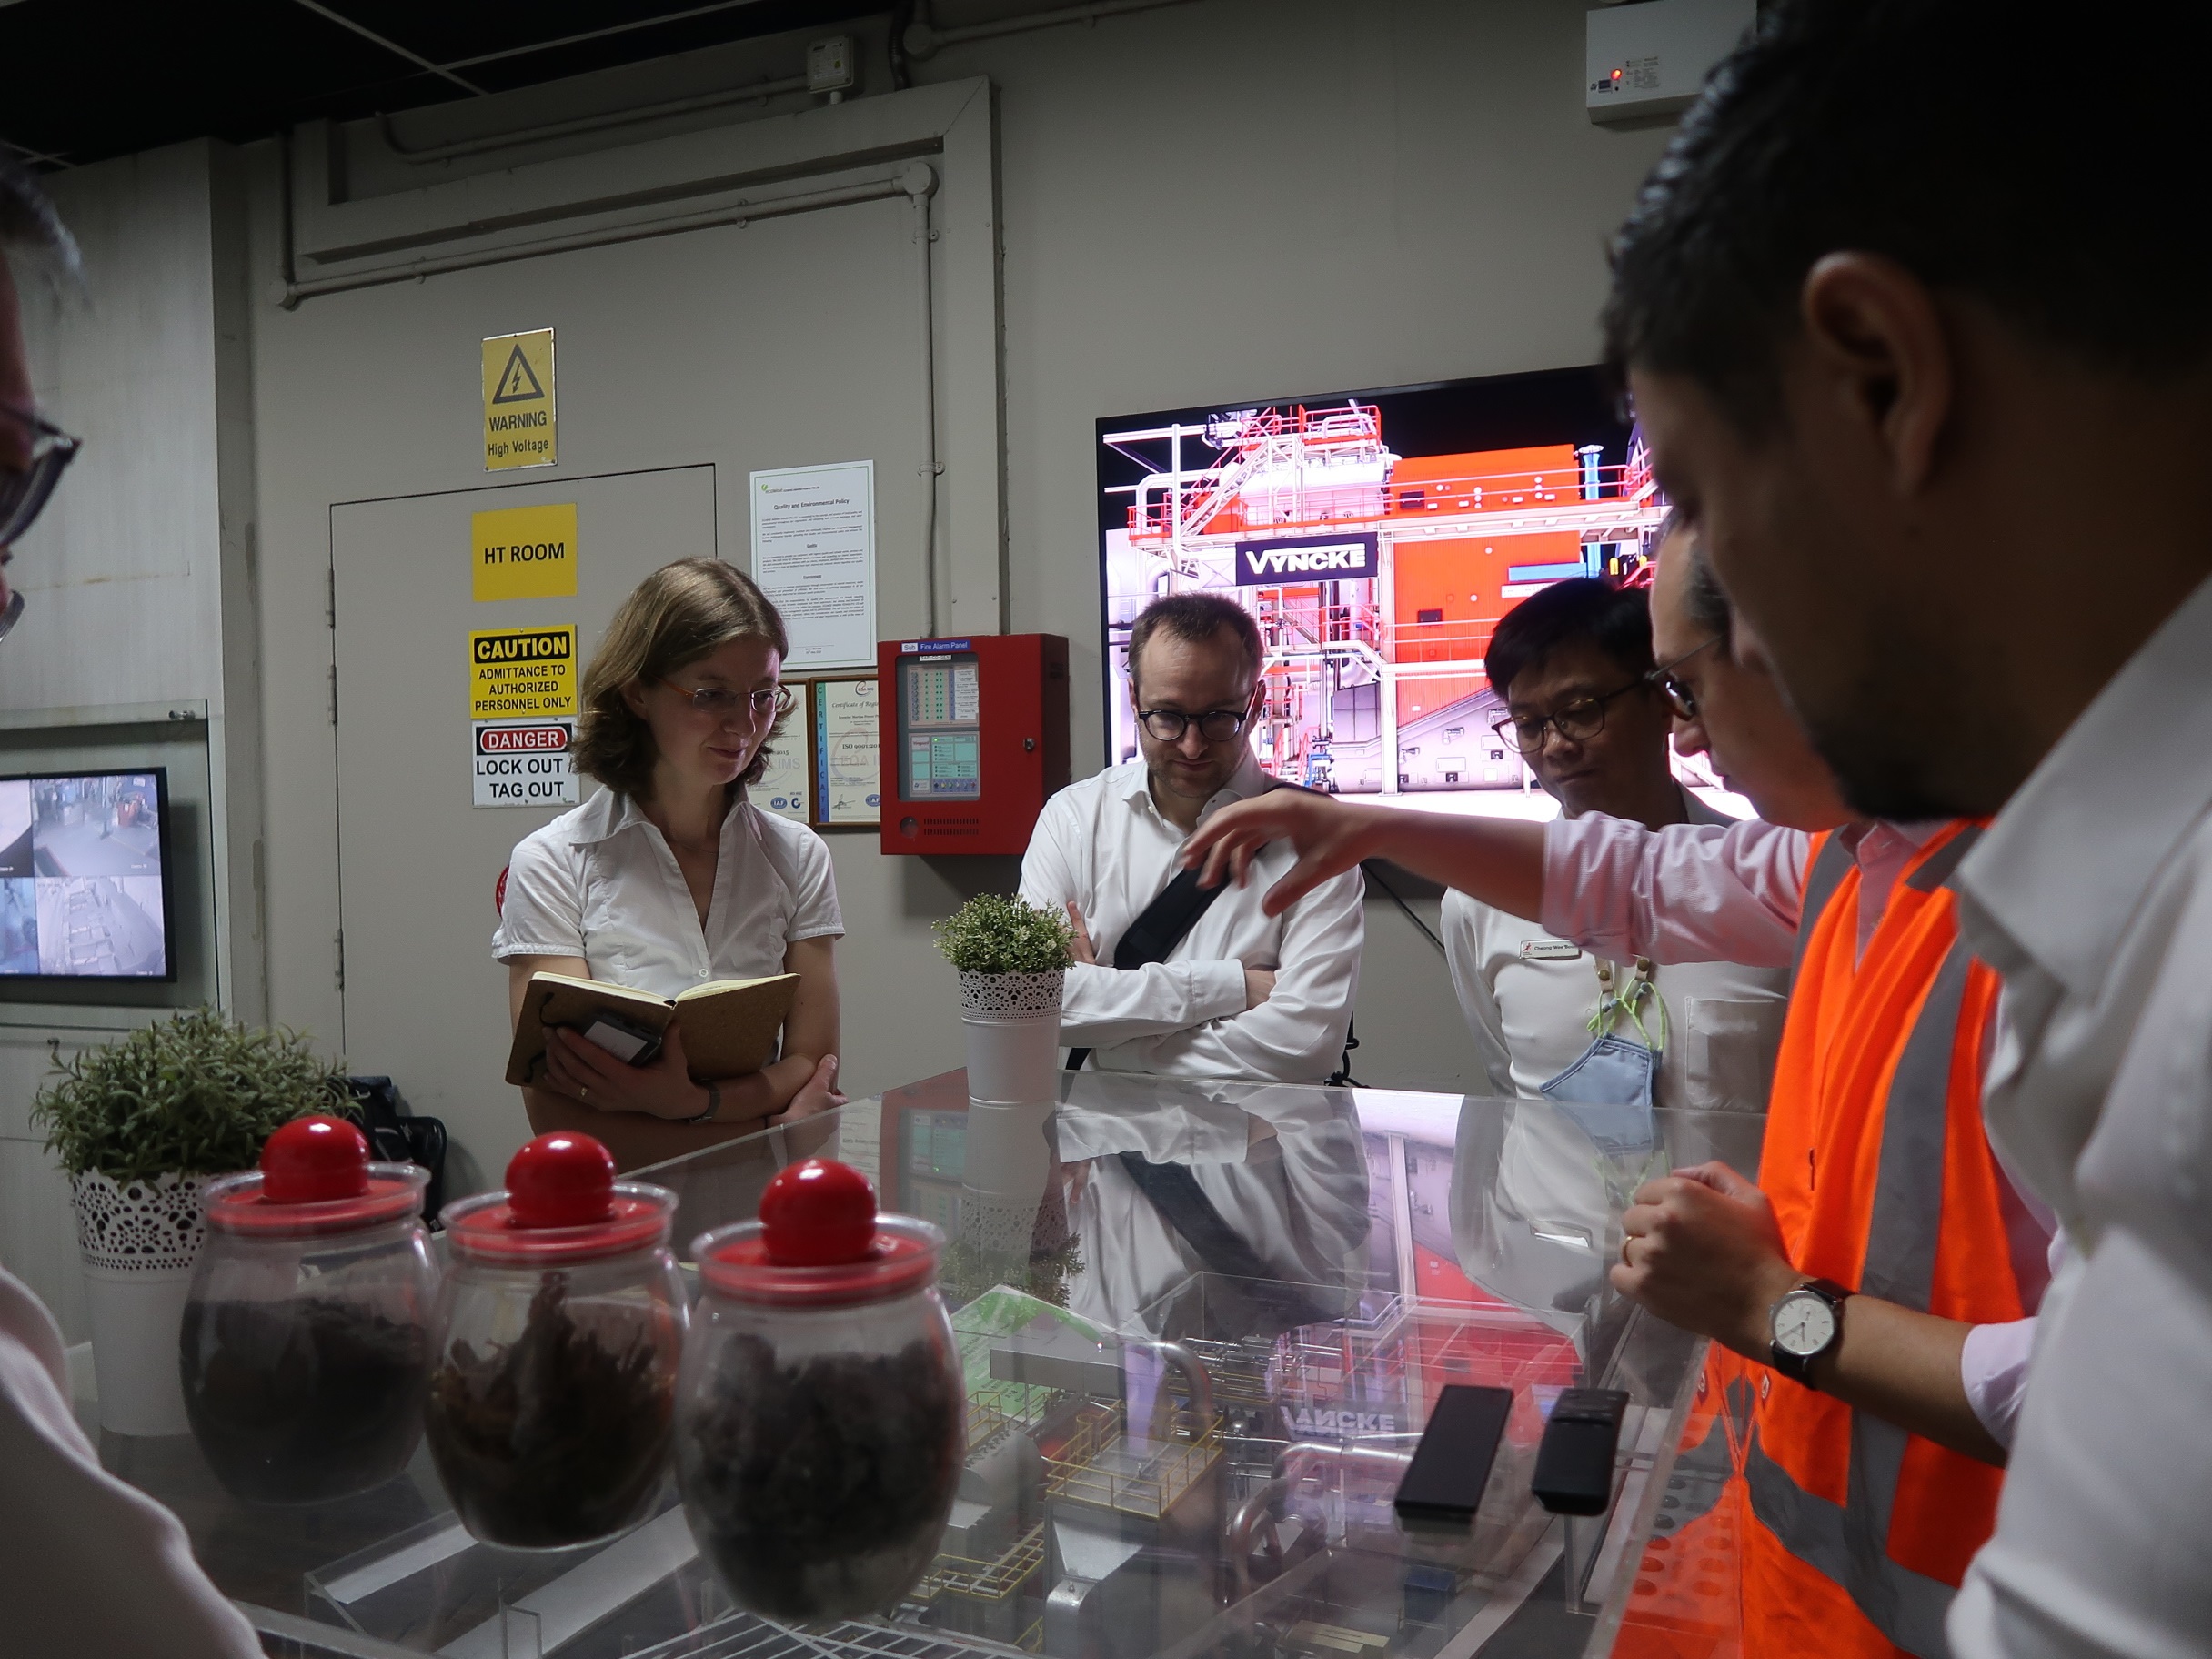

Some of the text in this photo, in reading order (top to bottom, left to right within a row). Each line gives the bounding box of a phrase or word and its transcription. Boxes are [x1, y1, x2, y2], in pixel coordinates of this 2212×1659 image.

[489, 410, 547, 432] WARNING
[488, 439, 548, 457] High Voltage
[801, 499, 834, 508] Environmental
[484, 542, 565, 564] HT ROOM
[1245, 543, 1365, 575] VYNCKE
[478, 636, 567, 660] CAUTION
[478, 664, 566, 680] ADMITTANCE TO
[488, 680, 558, 696] AUTHORIZED
[475, 696, 572, 711] PERSONNEL ONLY
[488, 730, 559, 749] DANGER
[476, 759, 523, 775] LOCK
[528, 759, 563, 774] OUT
[489, 781, 564, 798] TAG OUT
